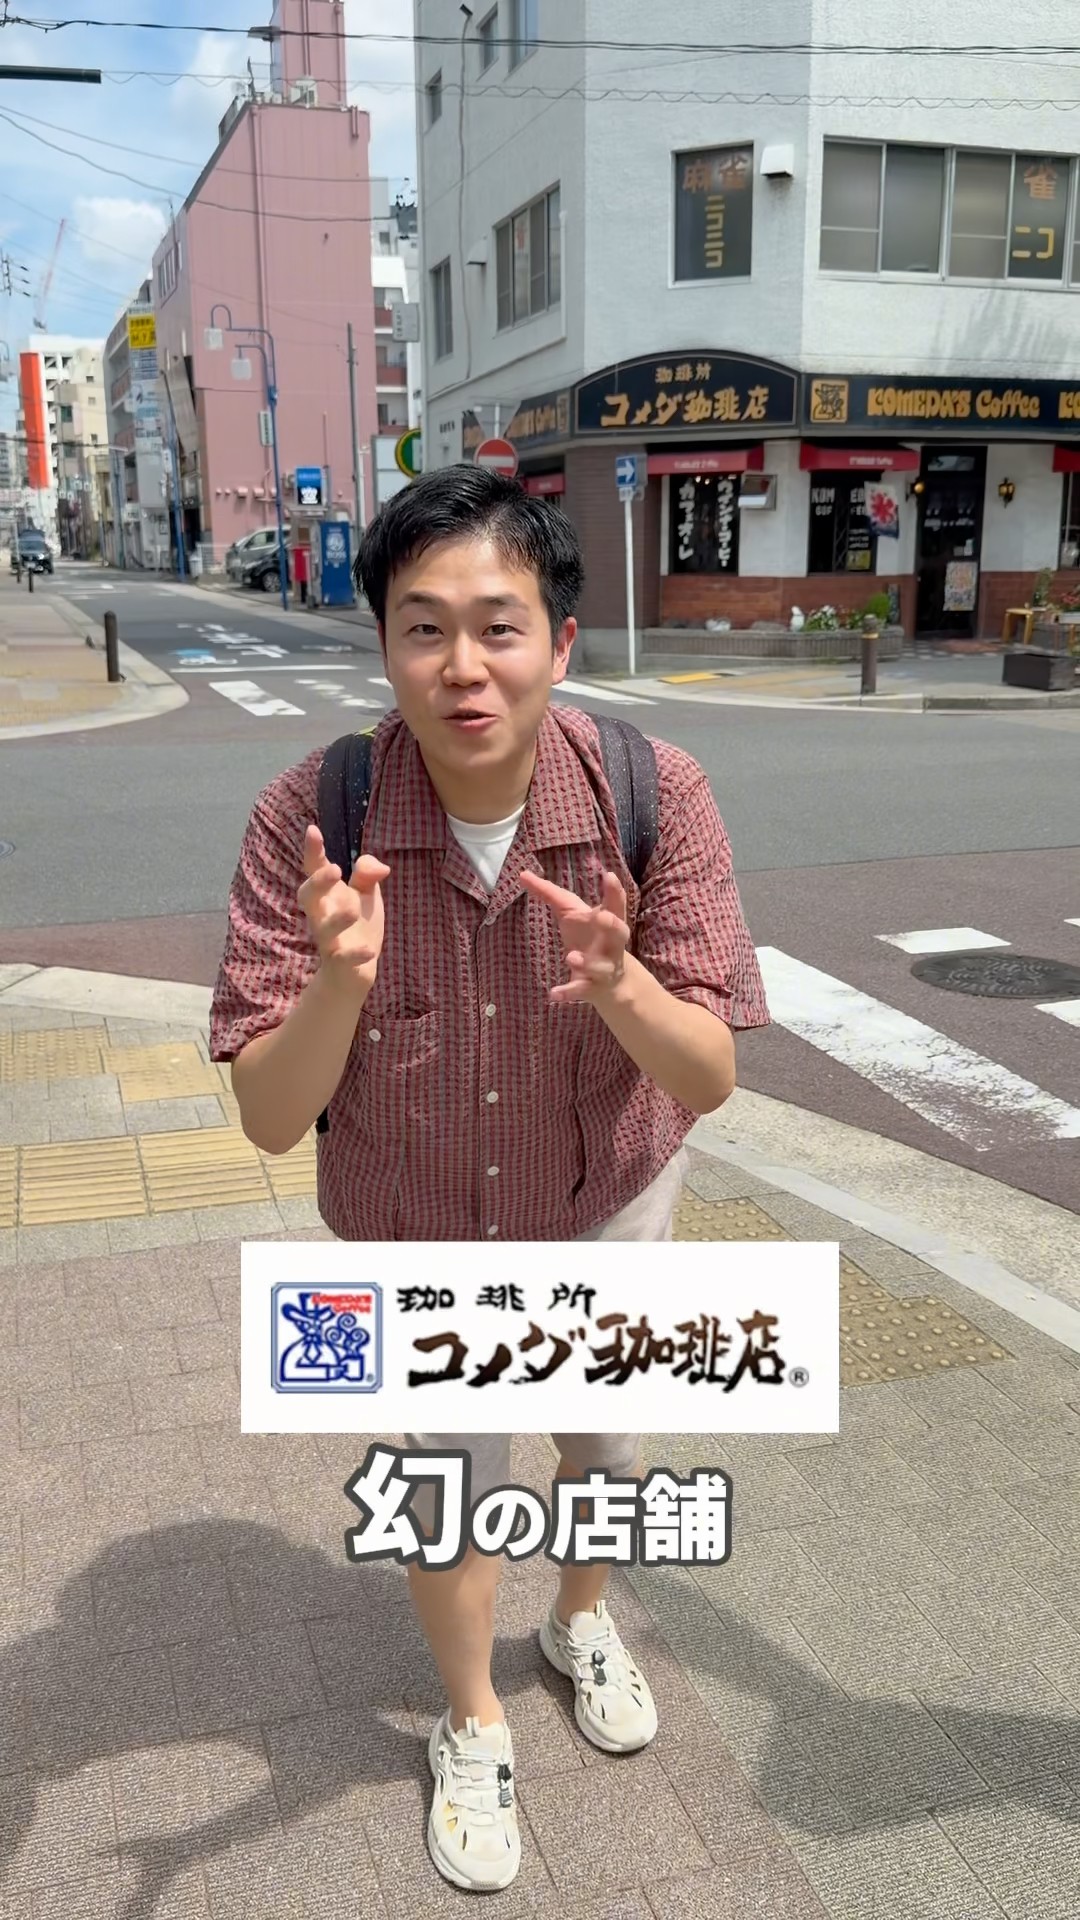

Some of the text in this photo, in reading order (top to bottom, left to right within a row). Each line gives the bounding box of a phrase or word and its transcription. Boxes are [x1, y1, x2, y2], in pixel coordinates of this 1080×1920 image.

[704, 195, 725, 269] ニコニコ
[1012, 226, 1055, 259] ニコ
[655, 362, 712, 383] 珈琲所
[601, 385, 769, 427] コメダ珈琲店
[867, 387, 971, 419] KOMEDA'S
[975, 389, 1041, 419] Coffee
